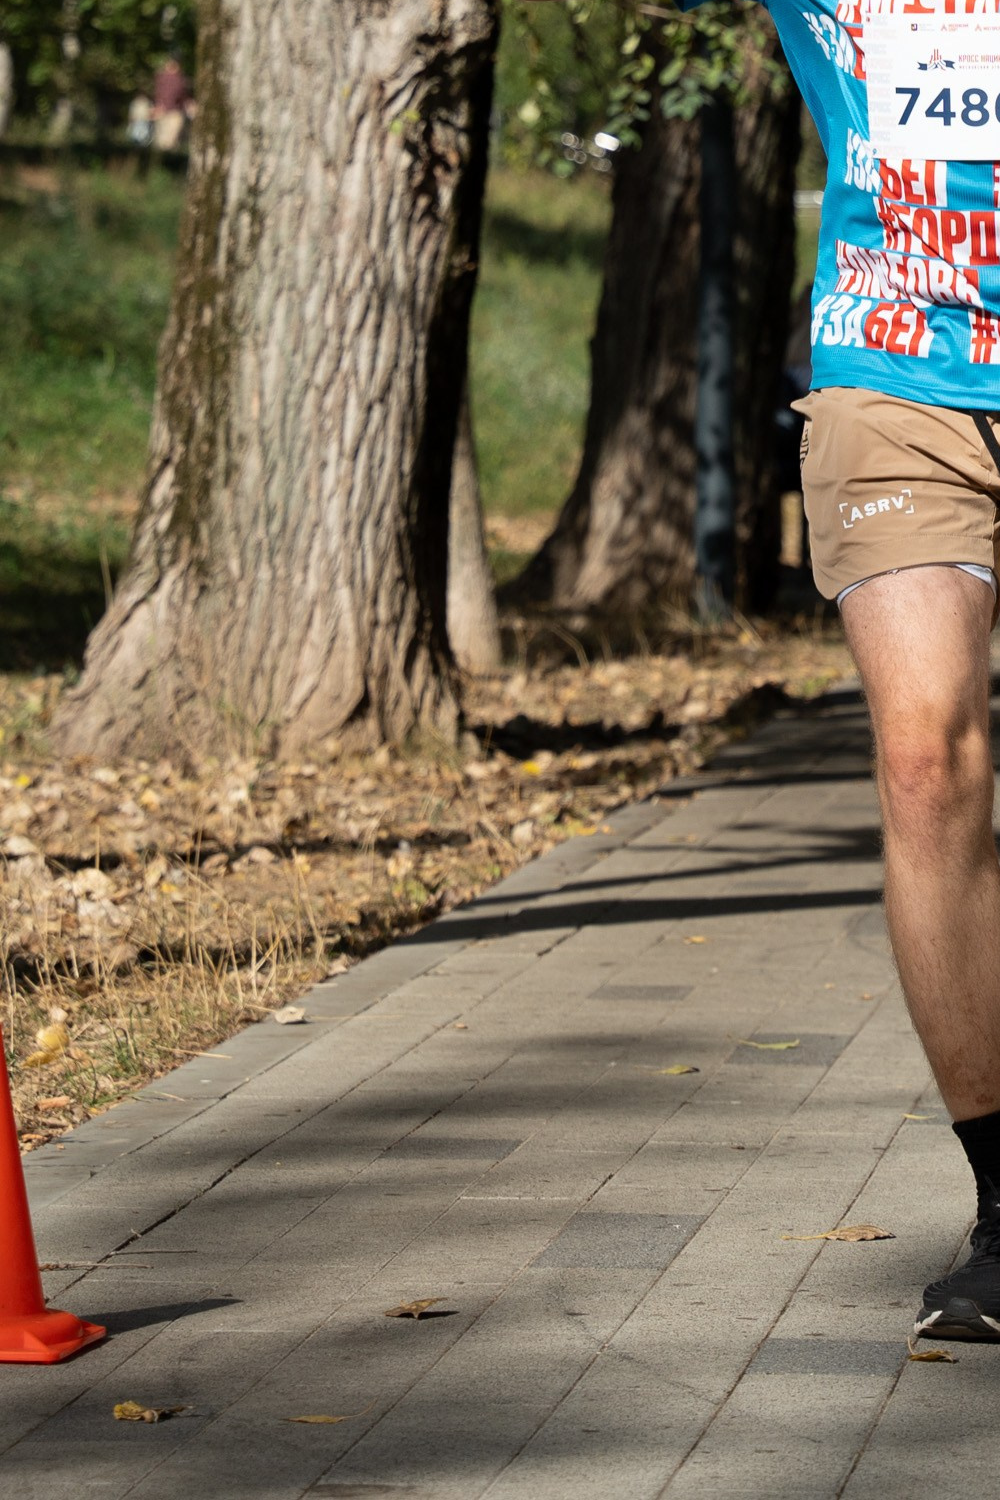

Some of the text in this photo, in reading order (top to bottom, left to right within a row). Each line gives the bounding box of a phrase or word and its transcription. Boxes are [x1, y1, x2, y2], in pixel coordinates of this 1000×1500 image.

[958, 54, 979, 63] КРОСС
[834, 240, 983, 308] #ЛЮБОВЬ
[811, 295, 934, 359] #ЗАБЕГ
[850, 495, 904, 522] ASRV
